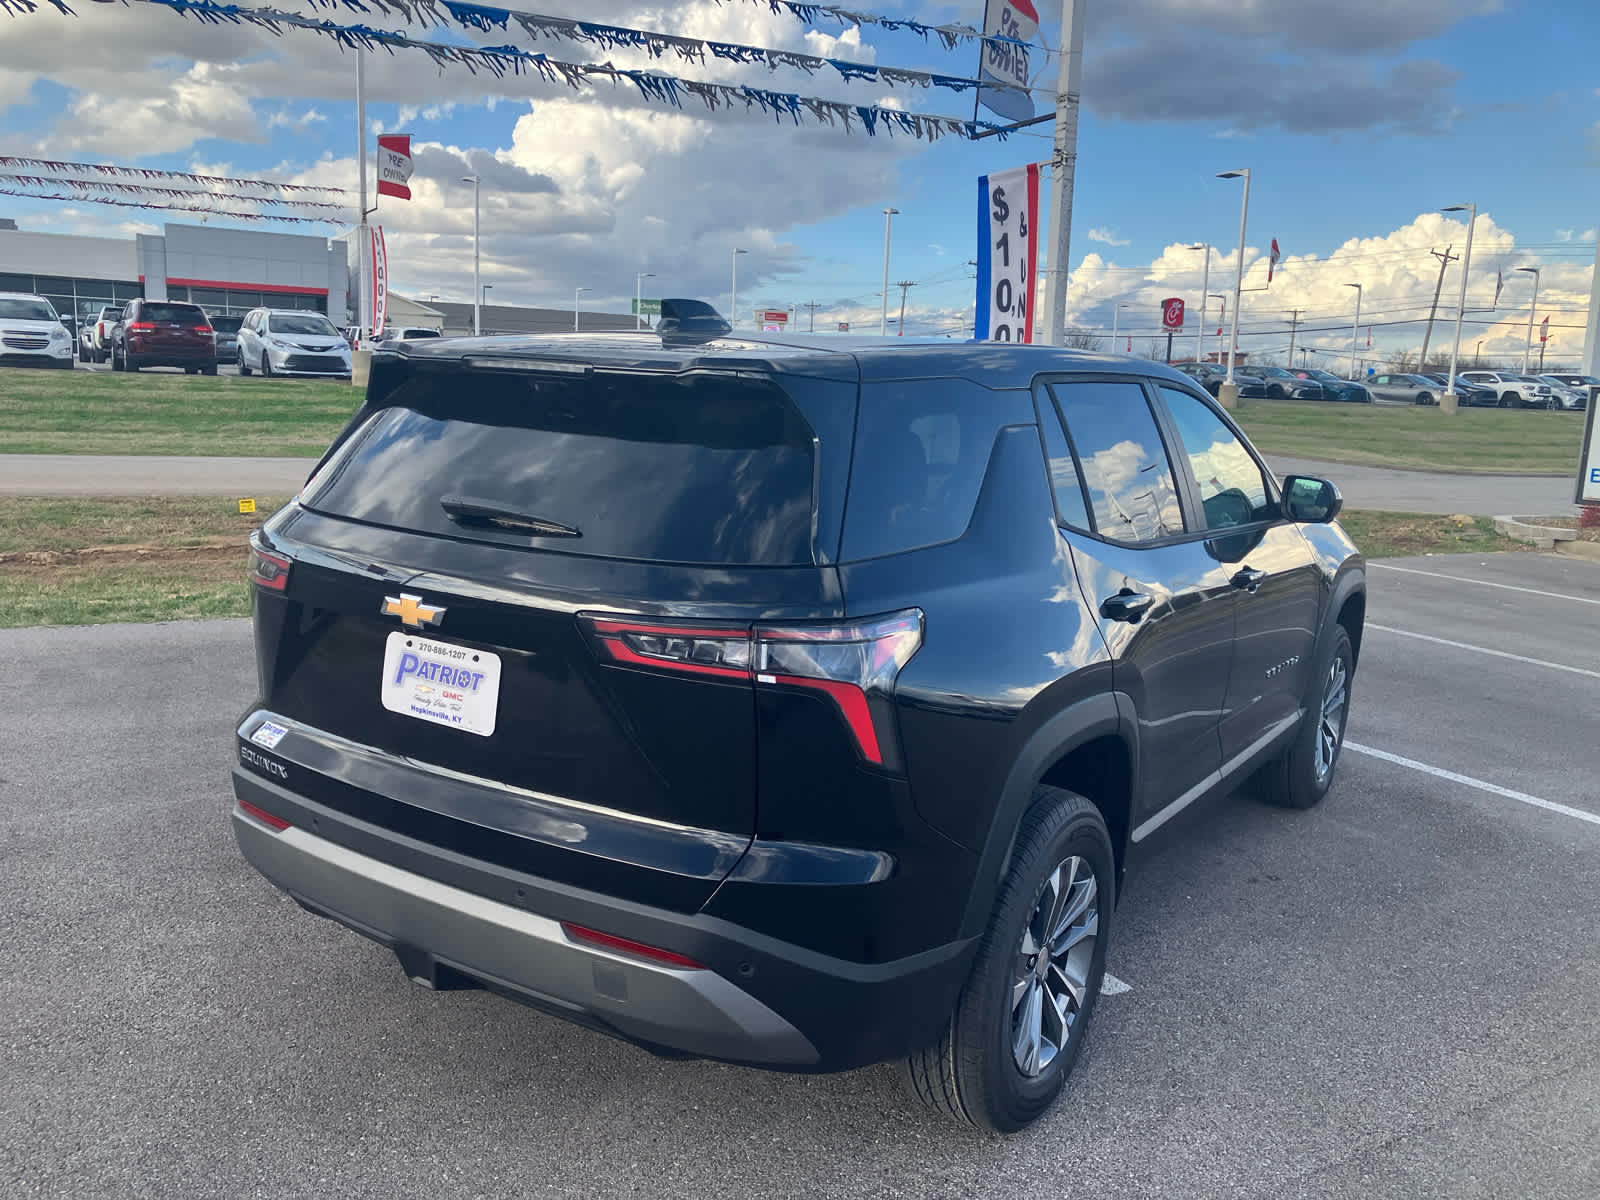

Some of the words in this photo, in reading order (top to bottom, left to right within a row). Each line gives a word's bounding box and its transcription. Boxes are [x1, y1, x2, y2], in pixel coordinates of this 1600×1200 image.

[395, 653, 484, 691] PATRIOT
[452, 714, 462, 724] KY
[241, 746, 288, 779] EQUINOX
